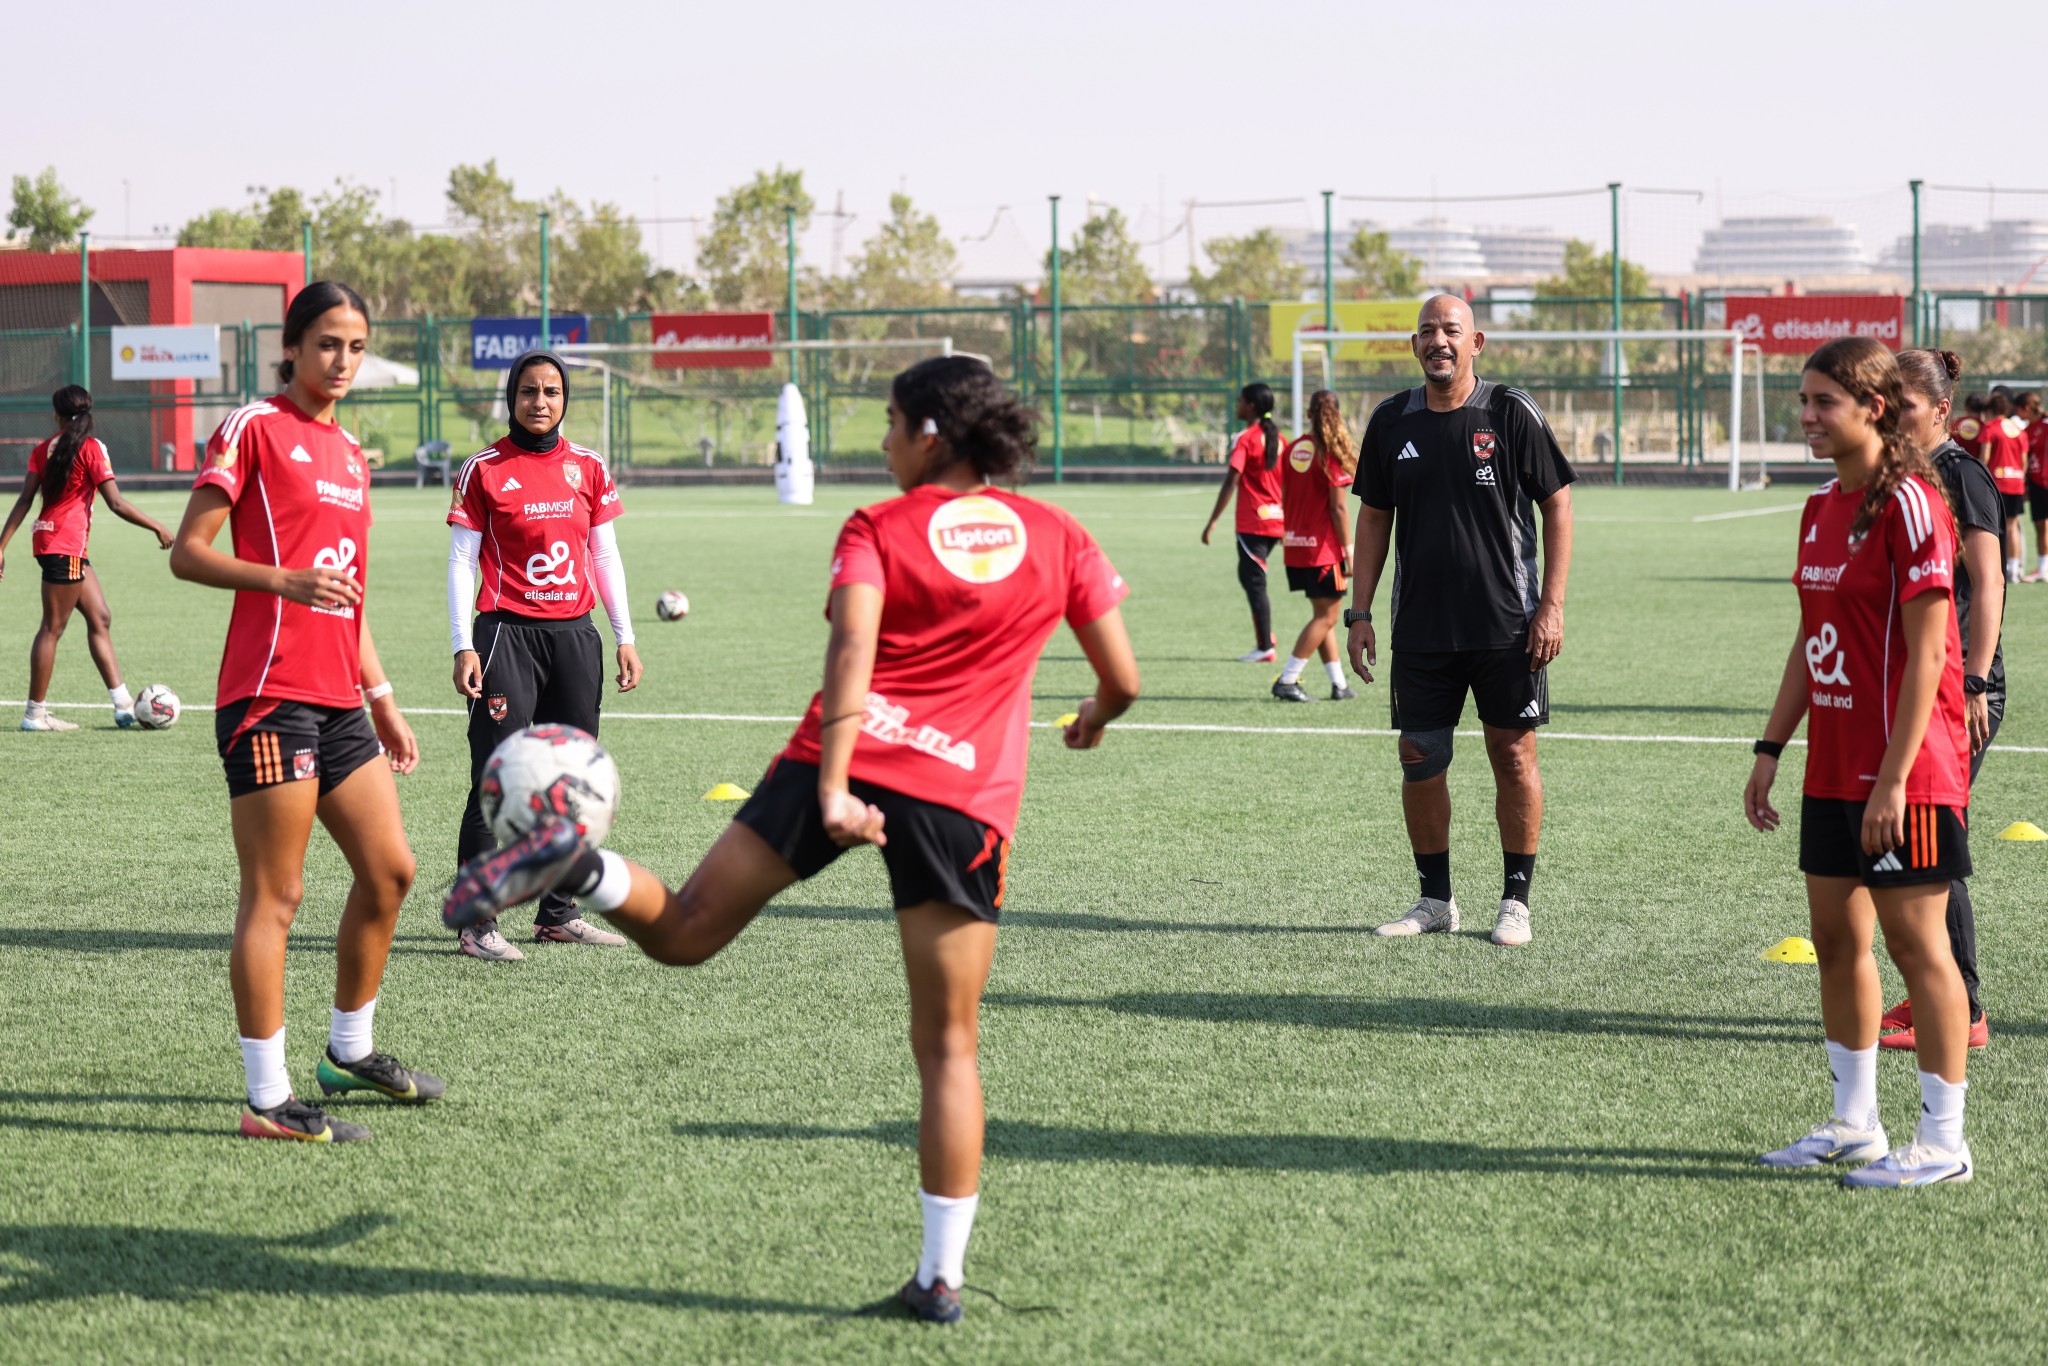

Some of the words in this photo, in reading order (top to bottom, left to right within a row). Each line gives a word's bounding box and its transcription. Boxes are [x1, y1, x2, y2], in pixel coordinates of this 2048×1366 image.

[1772, 317, 1852, 339] etisalat
[1855, 318, 1899, 339] and
[523, 500, 572, 516] FABMISR
[942, 527, 1013, 551] Lipton
[1921, 559, 1949, 577] GLC
[525, 590, 563, 601] etisalat
[1833, 694, 1853, 709] and
